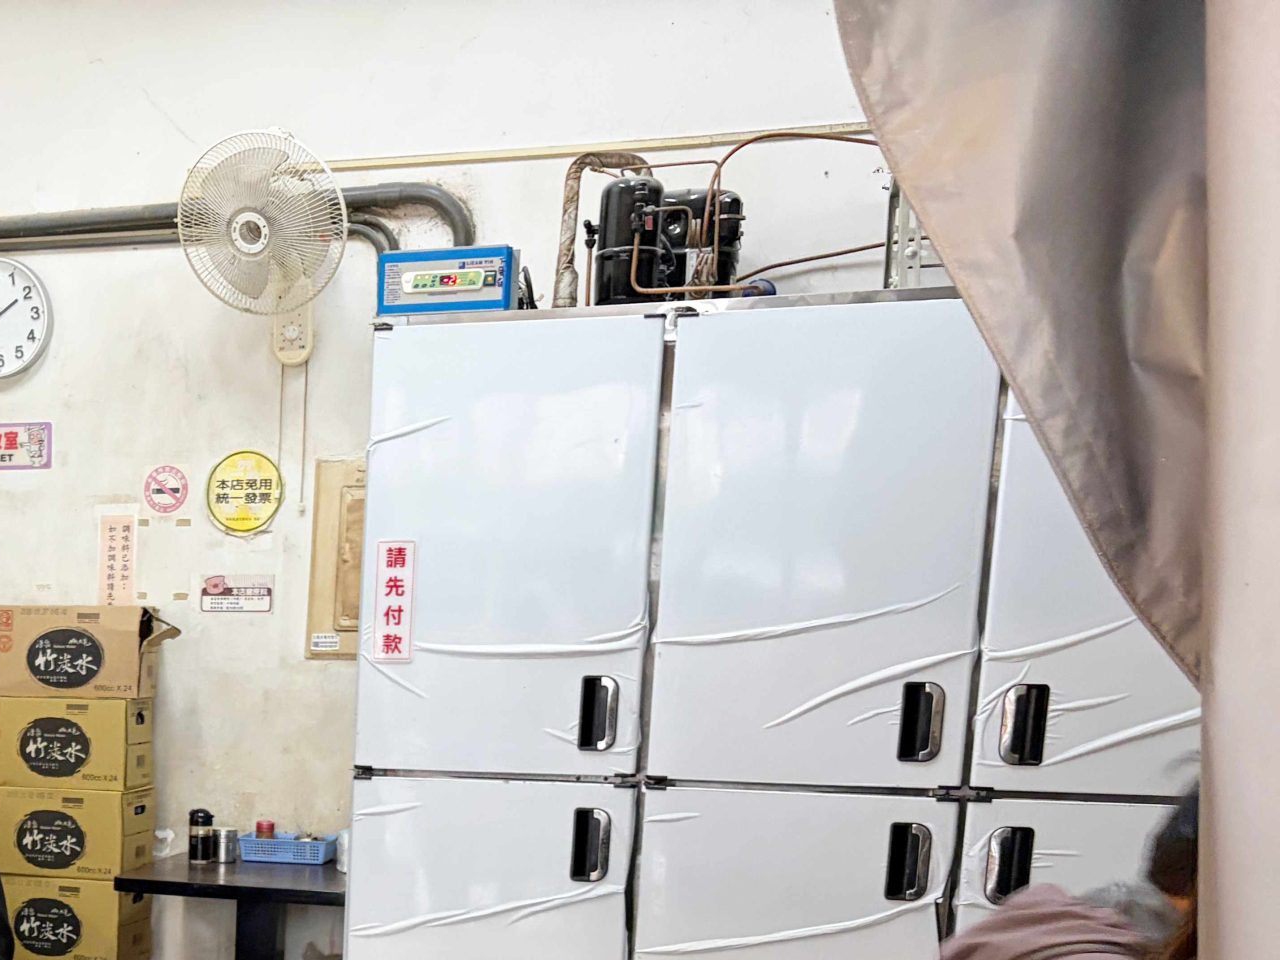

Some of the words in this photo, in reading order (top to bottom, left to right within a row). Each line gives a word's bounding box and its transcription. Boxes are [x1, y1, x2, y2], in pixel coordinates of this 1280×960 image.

[8, 272, 16, 286] 1
[23, 286, 32, 300] 2
[30, 306, 40, 320] 3
[27, 329, 36, 342] 4
[15, 345, 24, 359] 5
[215, 478, 273, 491] 本店免用
[215, 492, 273, 504] 統一發票
[382, 547, 407, 655] 請先付款
[34, 648, 99, 675] 竹炭水
[25, 737, 86, 763] 竹炭水
[22, 829, 81, 856] 竹炭水
[20, 917, 77, 944] 竹炭水
